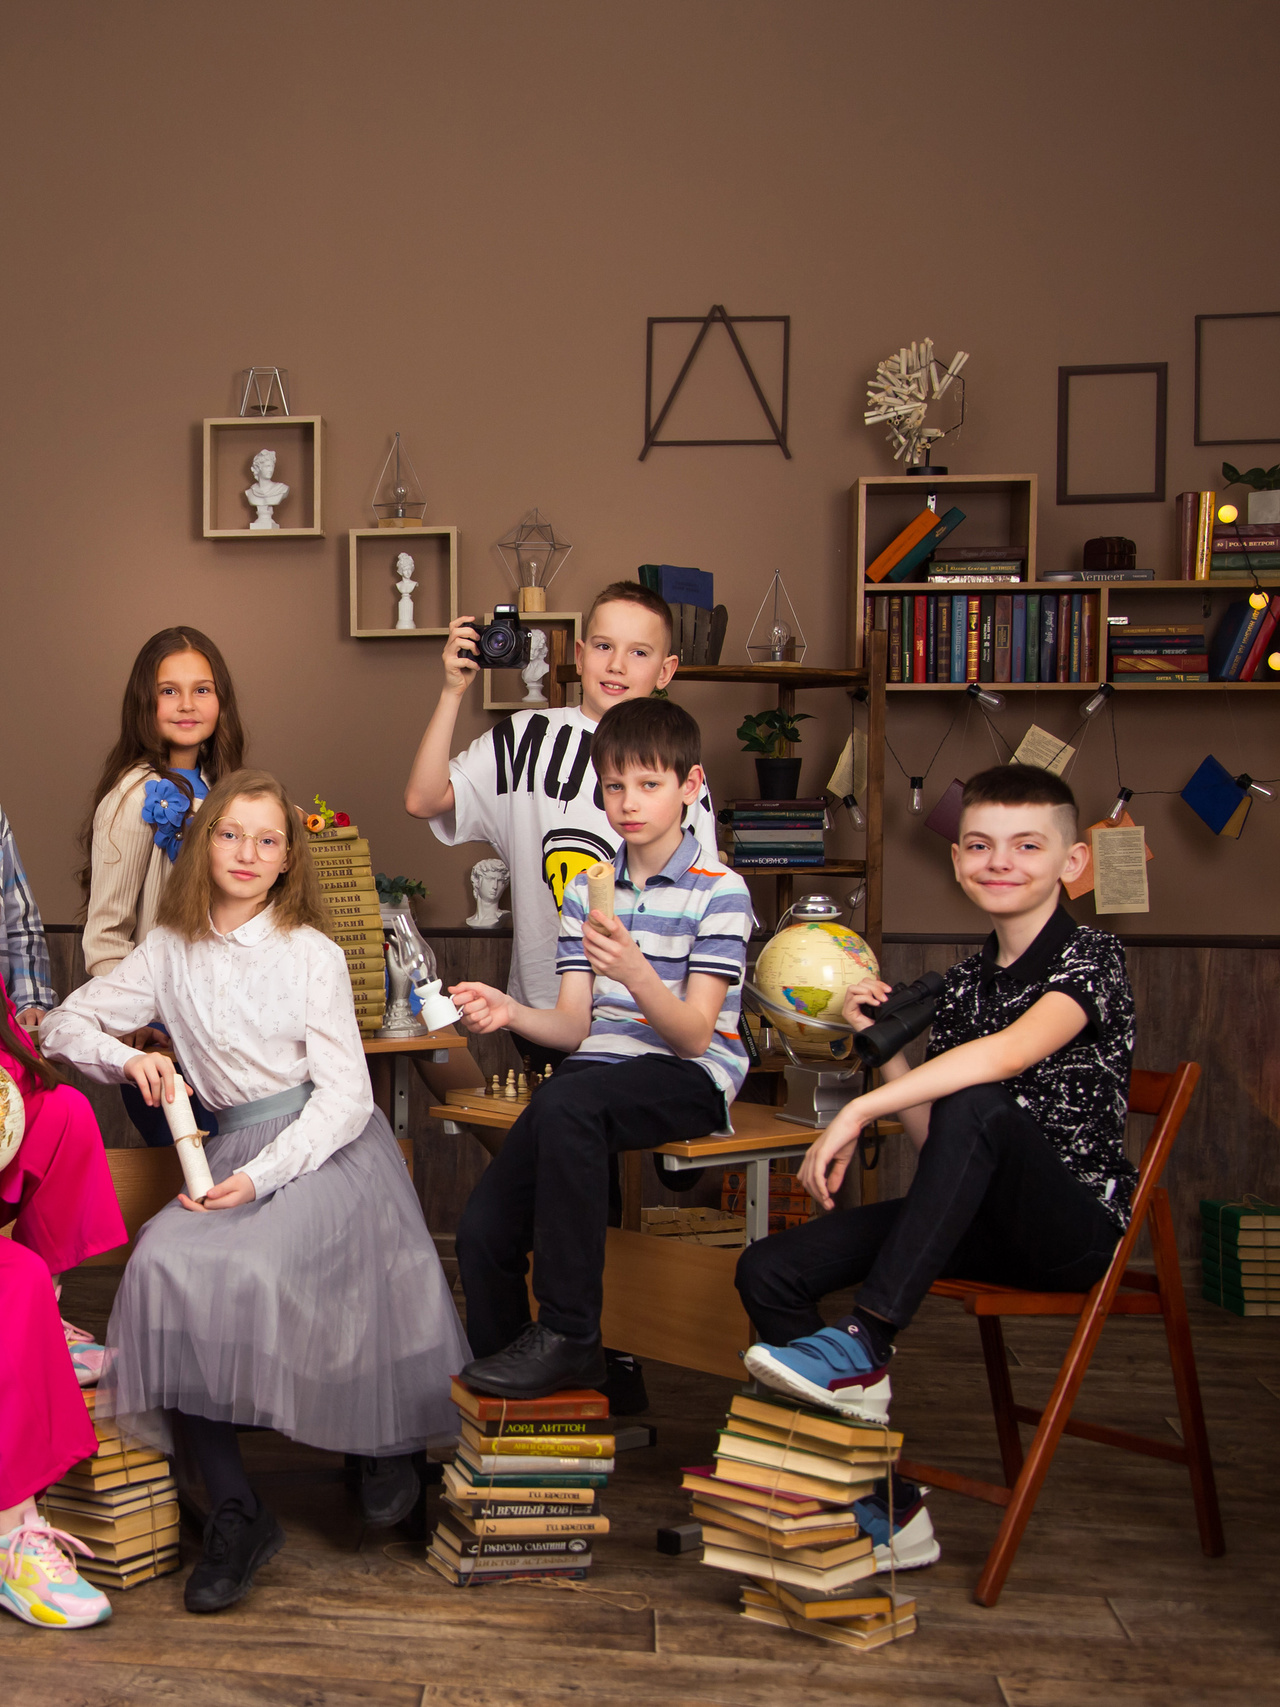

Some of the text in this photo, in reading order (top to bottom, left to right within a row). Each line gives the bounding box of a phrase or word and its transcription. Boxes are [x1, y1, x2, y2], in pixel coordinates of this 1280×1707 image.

[1080, 571, 1125, 581] Vermeer
[309, 843, 351, 853] ОРЬКИЙ
[314, 858, 353, 867] ОРЬКИЙ
[317, 868, 353, 878] РЬКИЙ
[323, 895, 361, 903] ОРЬКИЙ
[332, 919, 364, 928] РЬКИЙ
[333, 933, 367, 942] РЬКИЙ
[505, 1424, 586, 1434] ЛОРД ЛИТТОН
[496, 1504, 545, 1516] ВЕЧНЫЙ
[545, 1505, 569, 1515] ЗОВ
[483, 1541, 567, 1553] РАФАЭЛЬ САБАТИНИ
[475, 1556, 579, 1568] ВИКТОР АСТАФЬЕВ
